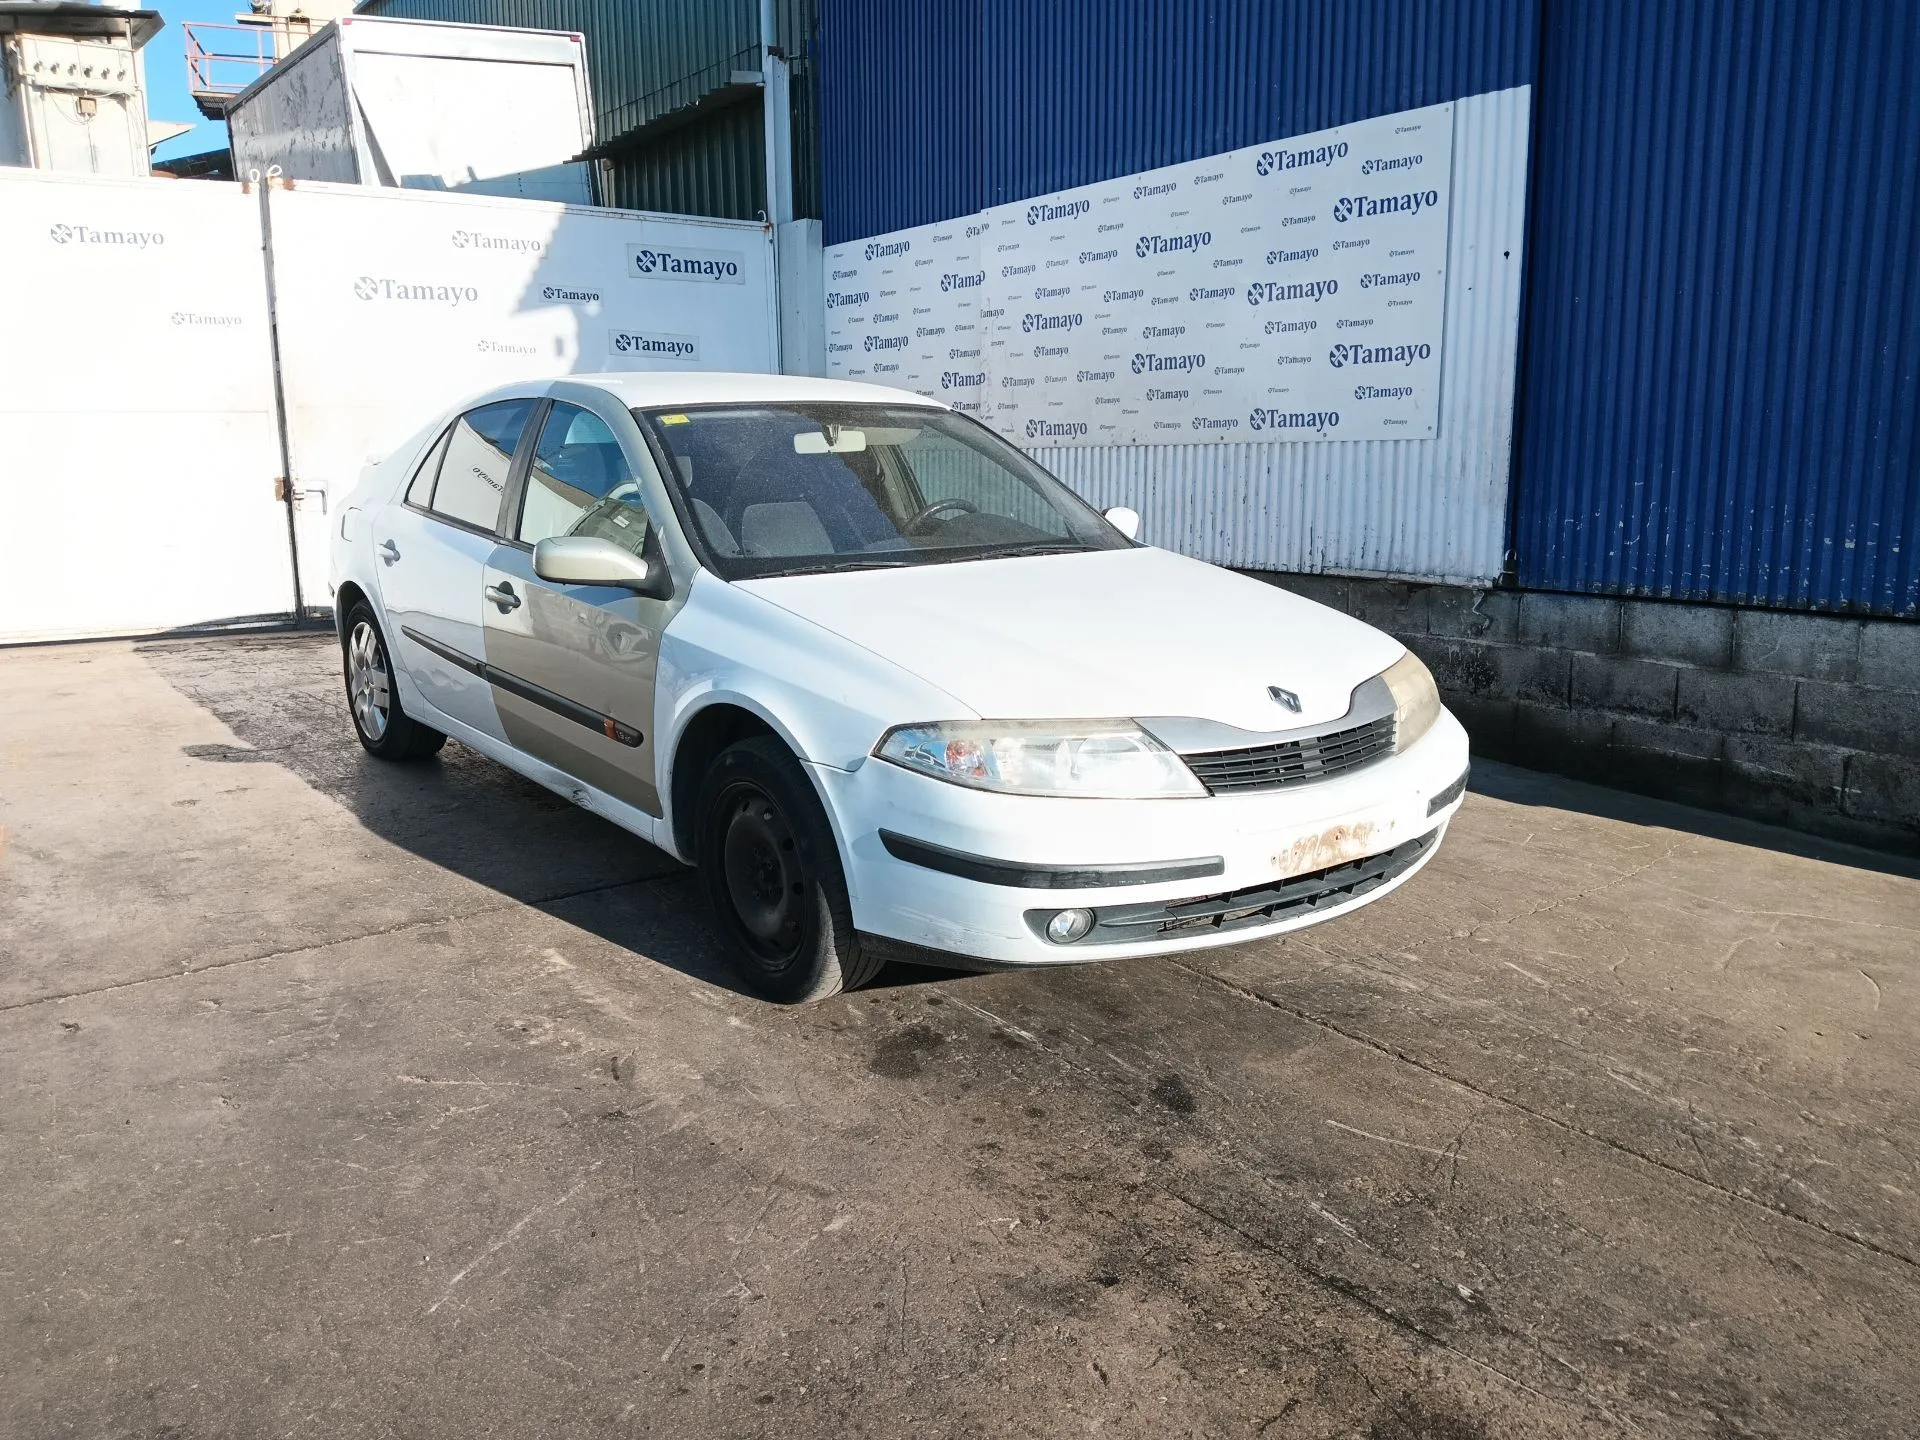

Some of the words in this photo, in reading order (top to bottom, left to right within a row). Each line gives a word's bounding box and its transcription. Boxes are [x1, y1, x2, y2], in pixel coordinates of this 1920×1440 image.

[1275, 142, 1348, 171] Tamayo
[1374, 155, 1422, 171] Tamayo
[1200, 173, 1224, 183] Tamayo
[1142, 183, 1176, 197] Tamayo
[1229, 193, 1252, 203] Tamayo
[1355, 191, 1438, 217] Tamayo
[1040, 200, 1089, 221] Tamayo
[1289, 216, 1315, 225] Tamayo
[73, 226, 164, 249] Tamayo
[470, 232, 541, 254] Tamayo
[1151, 232, 1211, 254] Tamayo
[1340, 239, 1370, 248] Tamayo
[874, 241, 909, 258] Tamayo
[1087, 250, 1117, 261] Tamayo
[1276, 248, 1318, 262] Tamayo
[657, 253, 738, 280] Tamayo
[1219, 259, 1242, 267] Tamayo
[1009, 265, 1036, 276] Tamayo
[1372, 272, 1420, 286] Tamayo
[379, 279, 478, 307] Tamayo
[555, 288, 600, 303] Tamayo
[1042, 287, 1070, 298] Tamayo
[1112, 289, 1143, 301] Tamayo
[1199, 288, 1235, 299] Tamayo
[1265, 280, 1338, 302] Tamayo
[835, 291, 869, 307] Tamayo
[1156, 296, 1178, 304] Tamayo
[184, 312, 242, 328] Tamayo
[878, 314, 899, 323] Tamayo
[1034, 314, 1082, 332] Tamayo
[1343, 319, 1373, 328] Tamayo
[922, 328, 945, 336] Tamayo
[1151, 326, 1185, 338] Tamayo
[1275, 320, 1317, 333] Tamayo
[632, 336, 694, 356] Tamayo
[873, 336, 908, 351] Tamayo
[956, 348, 982, 359] Tamayo
[1041, 347, 1068, 357] Tamayo
[1349, 344, 1430, 366] Tamayo
[1147, 354, 1205, 374] Tamayo
[1285, 356, 1311, 365] Tamayo
[1085, 371, 1115, 382] Tamayo
[1220, 367, 1244, 375] Tamayo
[1009, 377, 1035, 388] Tamayo
[1155, 389, 1188, 401] Tamayo
[1366, 386, 1412, 400] Tamayo
[1159, 422, 1181, 430] Tamayo
[1201, 418, 1238, 430] Tamayo
[1268, 409, 1339, 432] Tamayo
[1038, 421, 1087, 439] Tamayo
